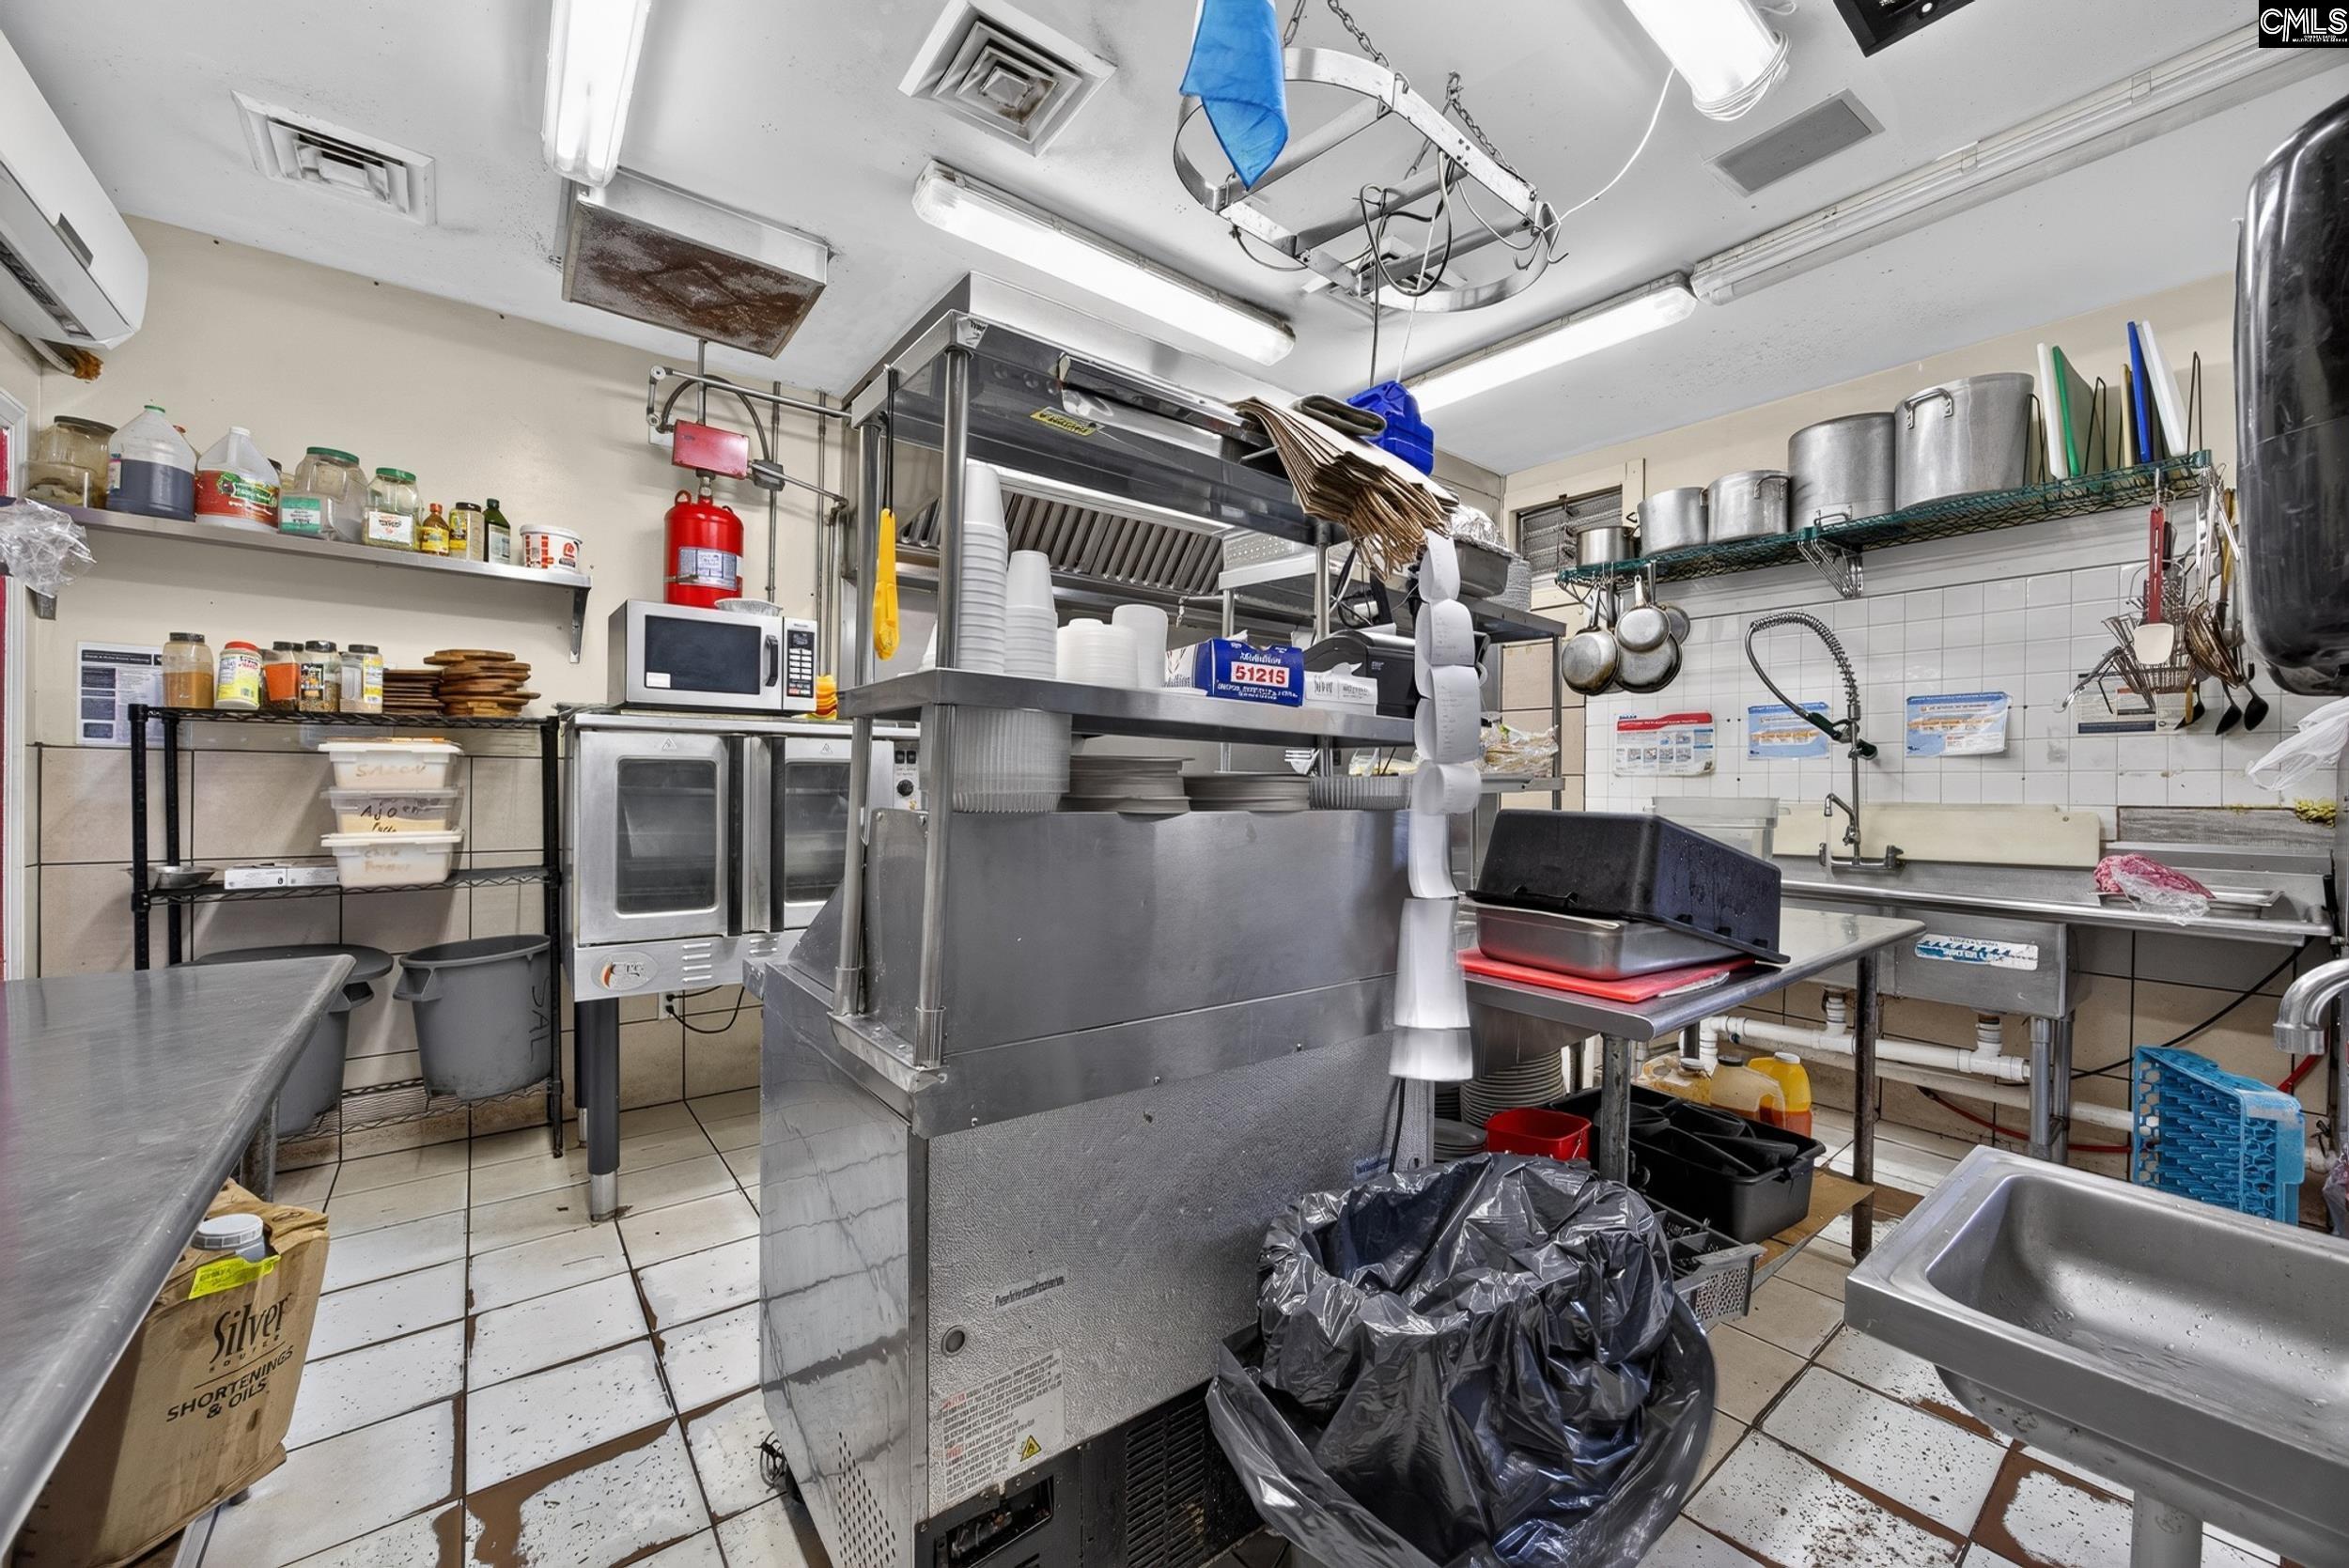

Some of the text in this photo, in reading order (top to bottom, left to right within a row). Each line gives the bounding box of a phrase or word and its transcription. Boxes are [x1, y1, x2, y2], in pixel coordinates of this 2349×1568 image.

[1236, 665, 1286, 685] 51215
[209, 1298, 289, 1364] Silver
[166, 1344, 294, 1422] SHORTENINGS
[206, 1378, 268, 1420] & OILS
